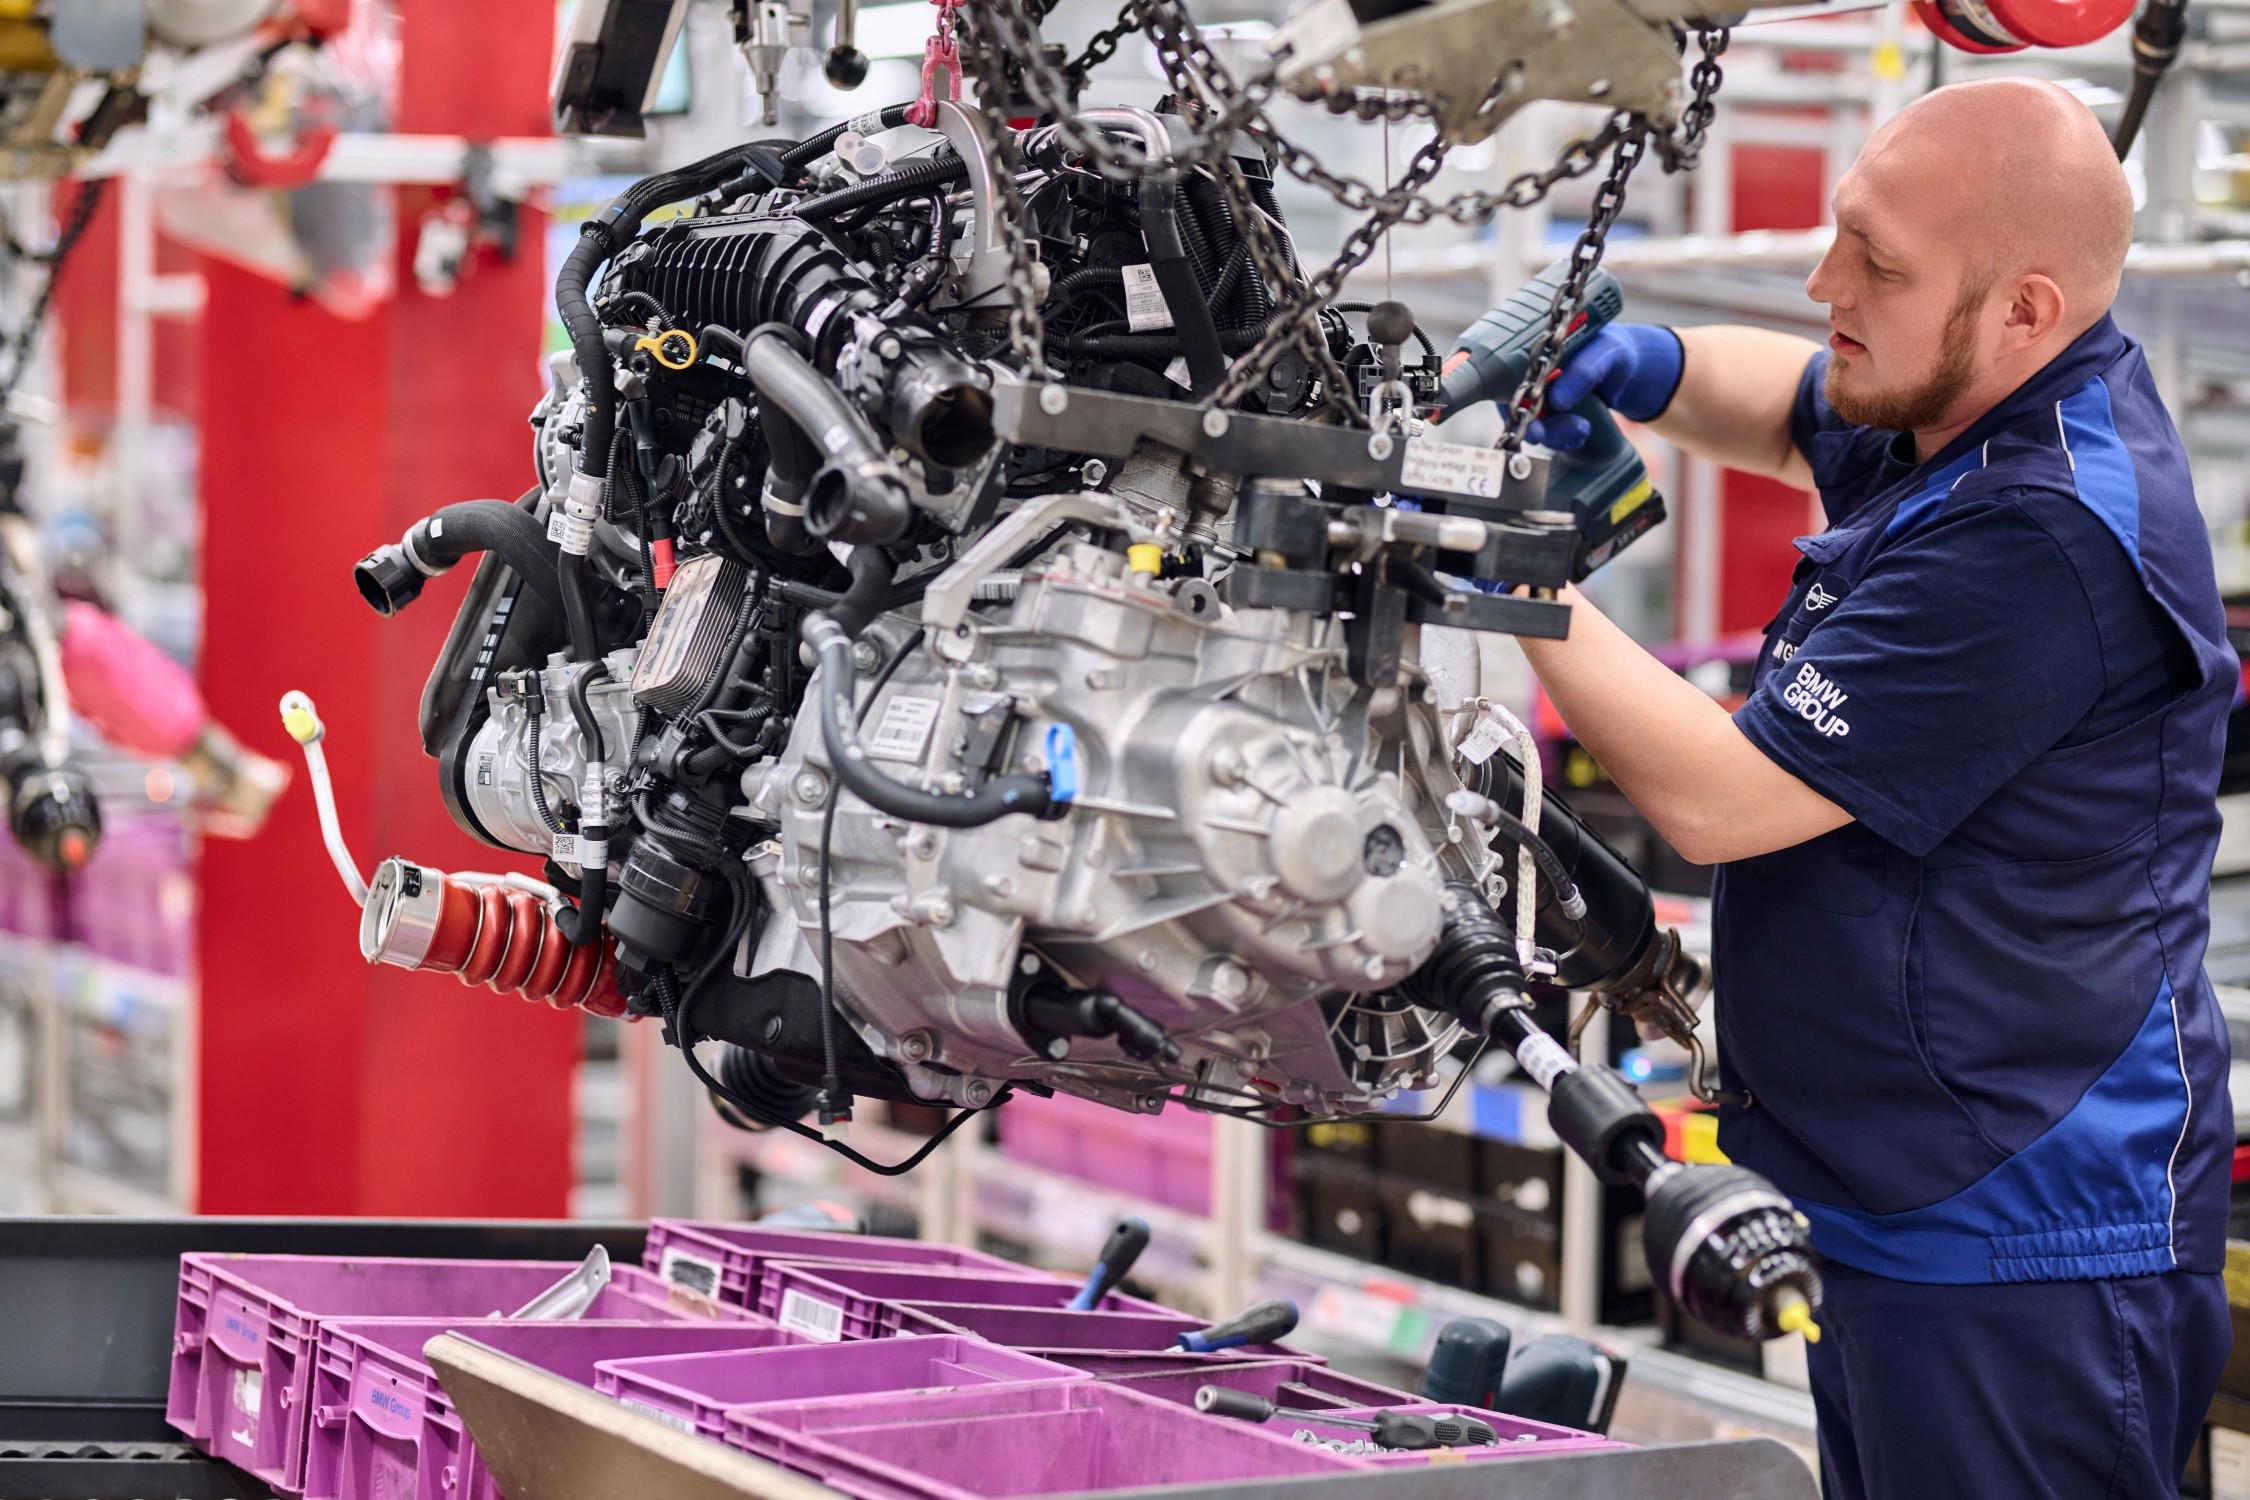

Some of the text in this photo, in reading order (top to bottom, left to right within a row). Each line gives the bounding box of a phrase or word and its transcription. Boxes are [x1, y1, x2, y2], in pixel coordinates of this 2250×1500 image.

[1783, 682, 1850, 738] GROUP
[1796, 662, 1848, 710] BMW
[372, 1388, 411, 1421] BMW Group
